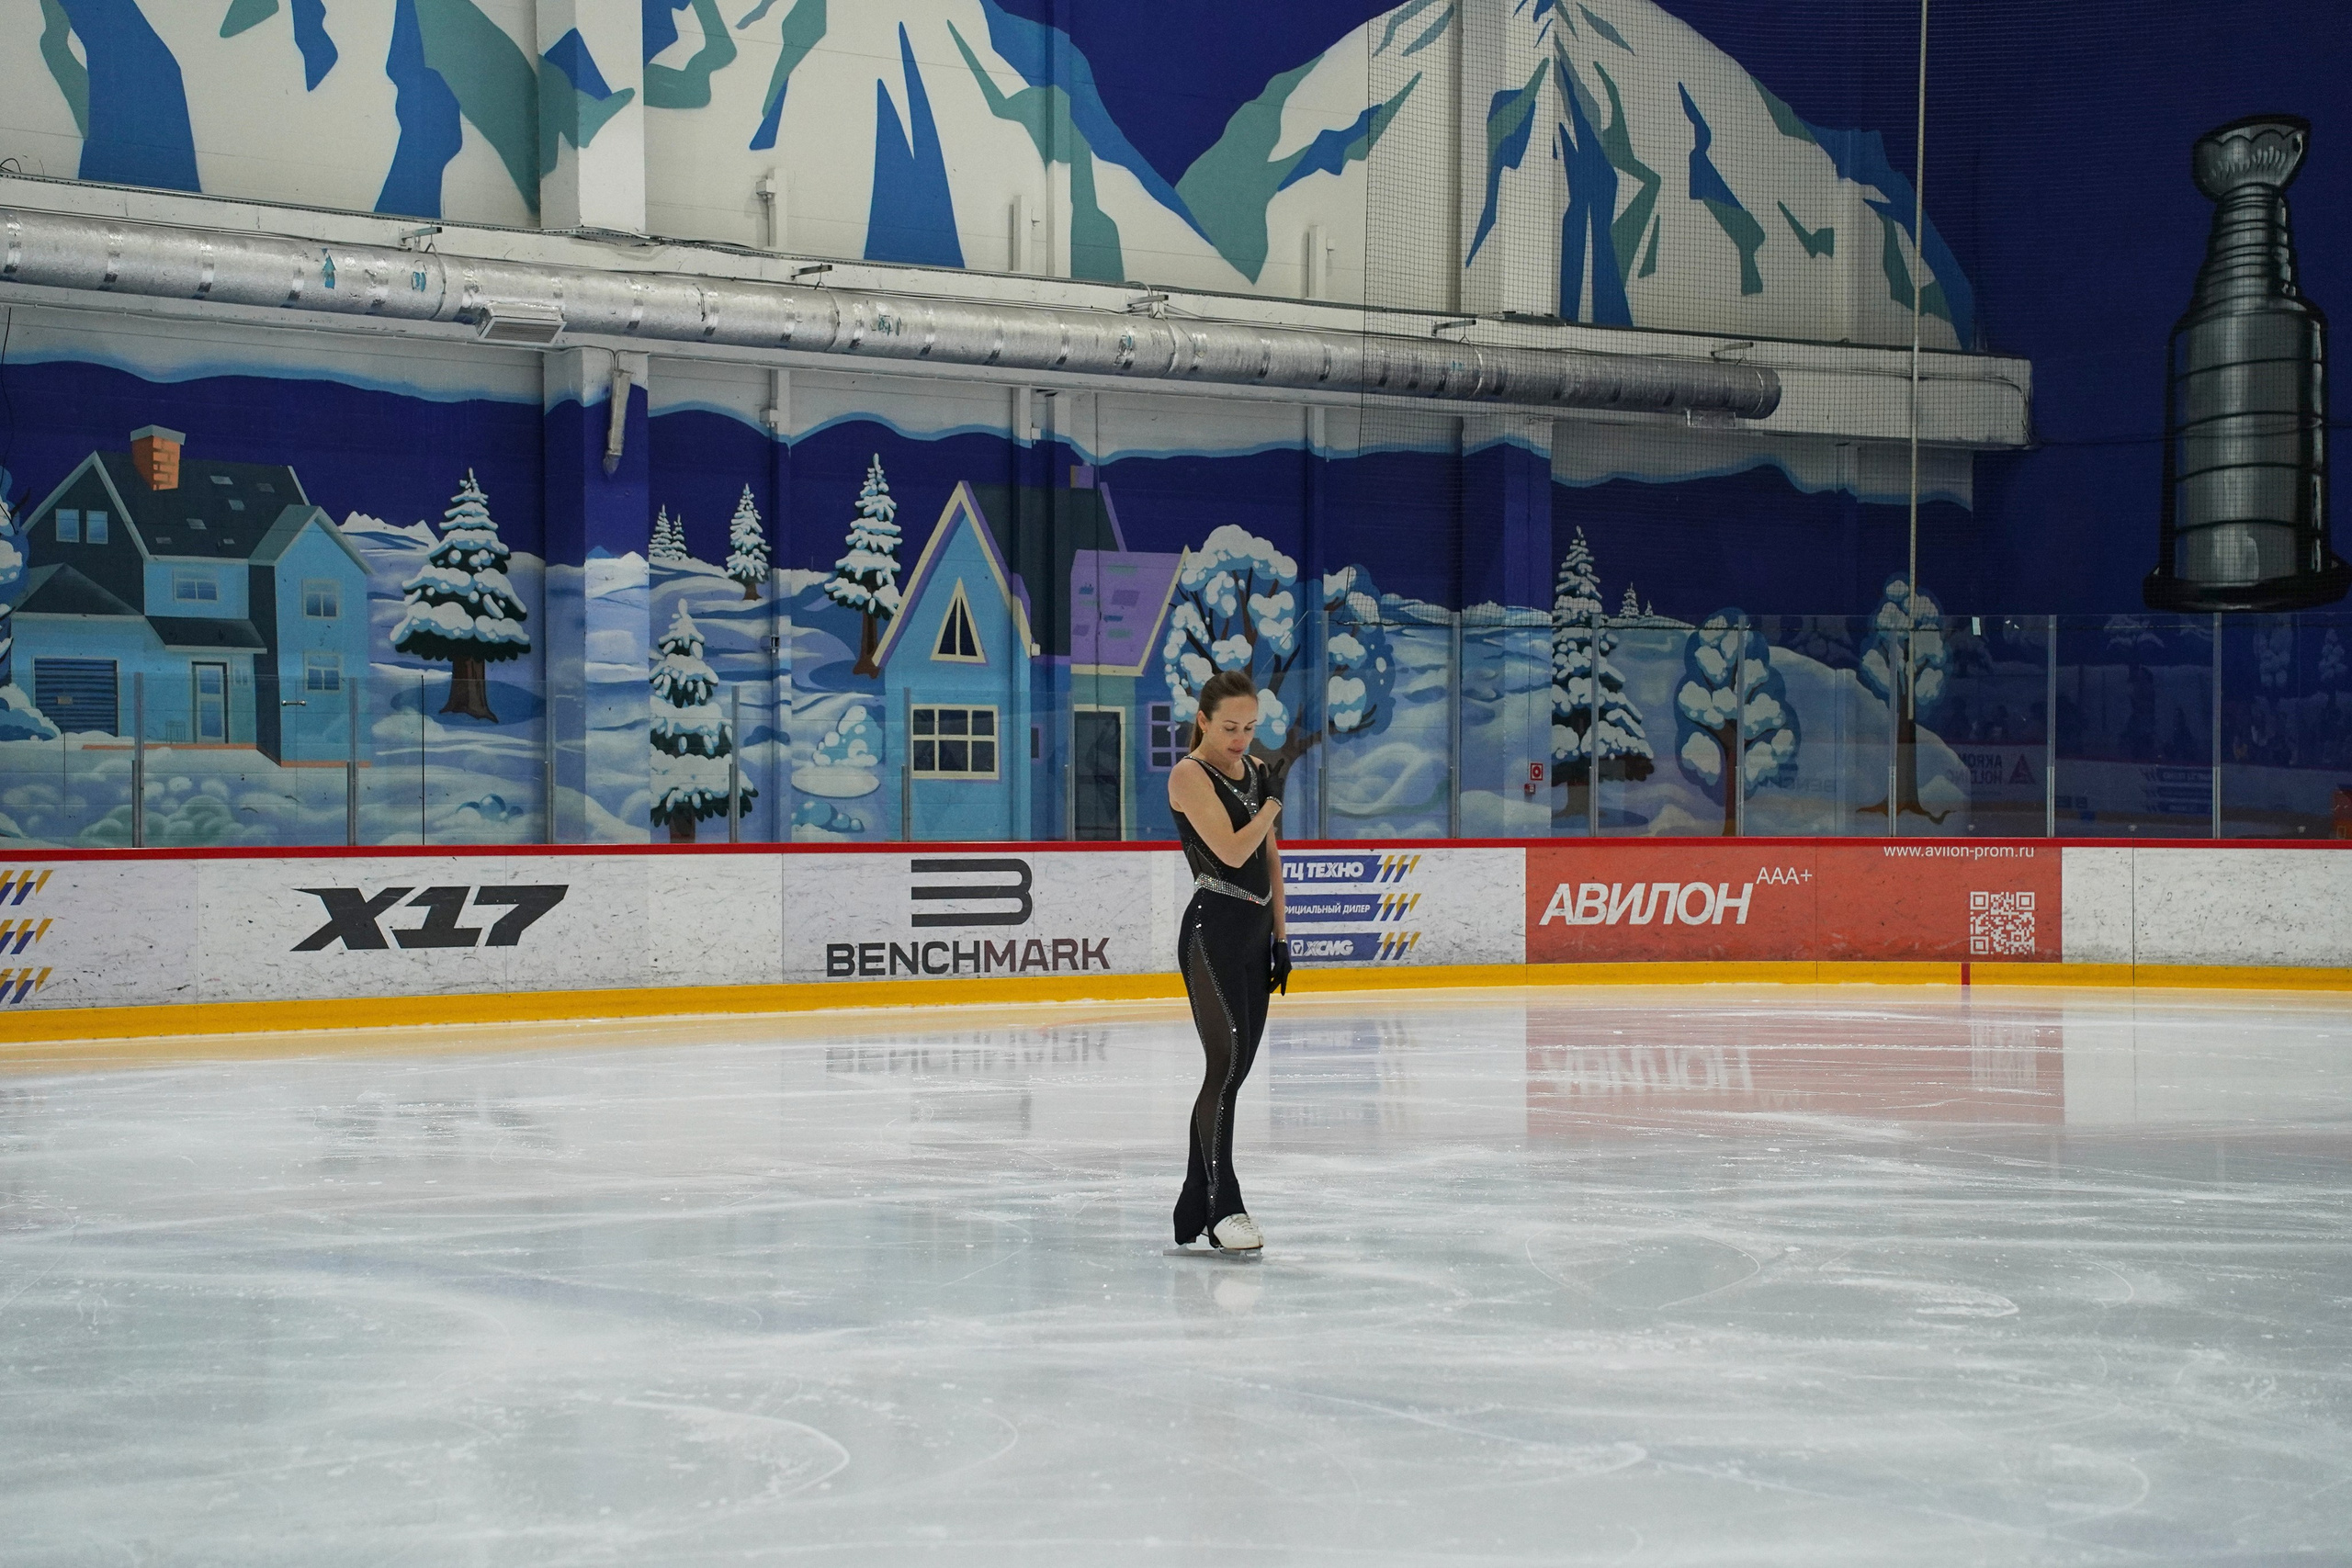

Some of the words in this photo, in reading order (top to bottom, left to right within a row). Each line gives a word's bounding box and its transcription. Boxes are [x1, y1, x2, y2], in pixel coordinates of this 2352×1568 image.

[1306, 861, 1365, 878] ТЕХНО
[1342, 904, 1372, 916] ДИЛЕР
[1538, 881, 1755, 926] АВИЛОН
[289, 884, 570, 952] X17
[826, 937, 1111, 977] BENCHMARK
[1303, 939, 1355, 956] XCMG
